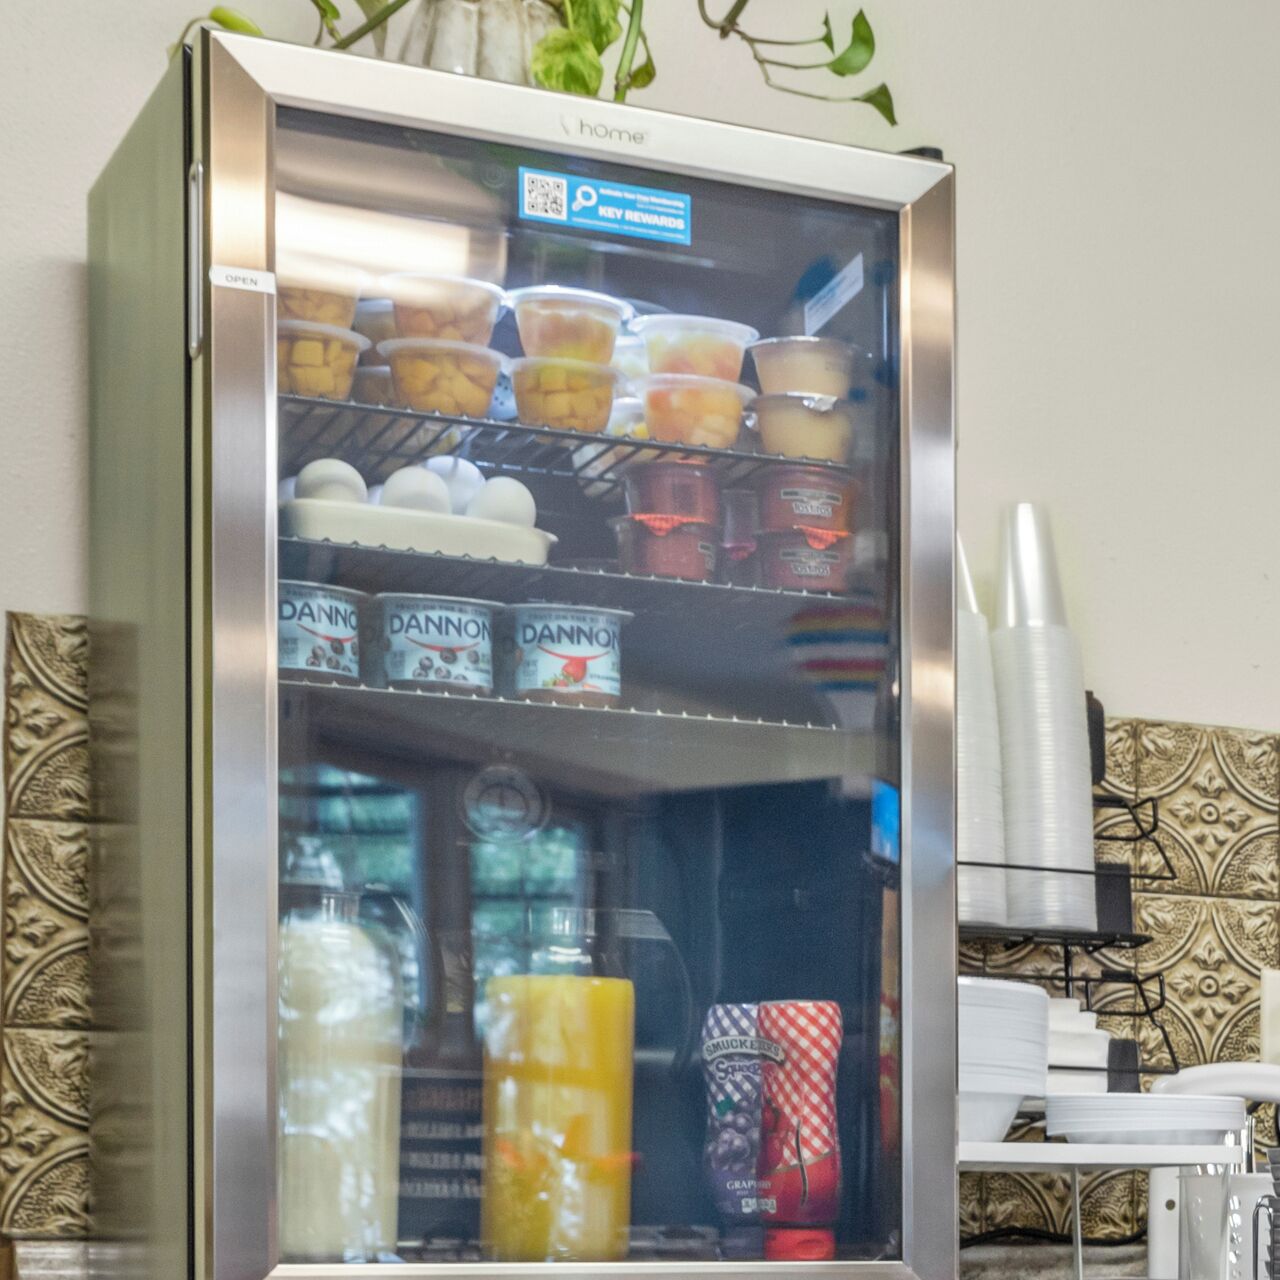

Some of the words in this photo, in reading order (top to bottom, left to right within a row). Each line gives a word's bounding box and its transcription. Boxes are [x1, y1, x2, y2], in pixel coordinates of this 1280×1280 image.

[598, 205, 623, 220] KEY
[625, 209, 686, 231] REWARDS
[225, 275, 258, 287] OPEN
